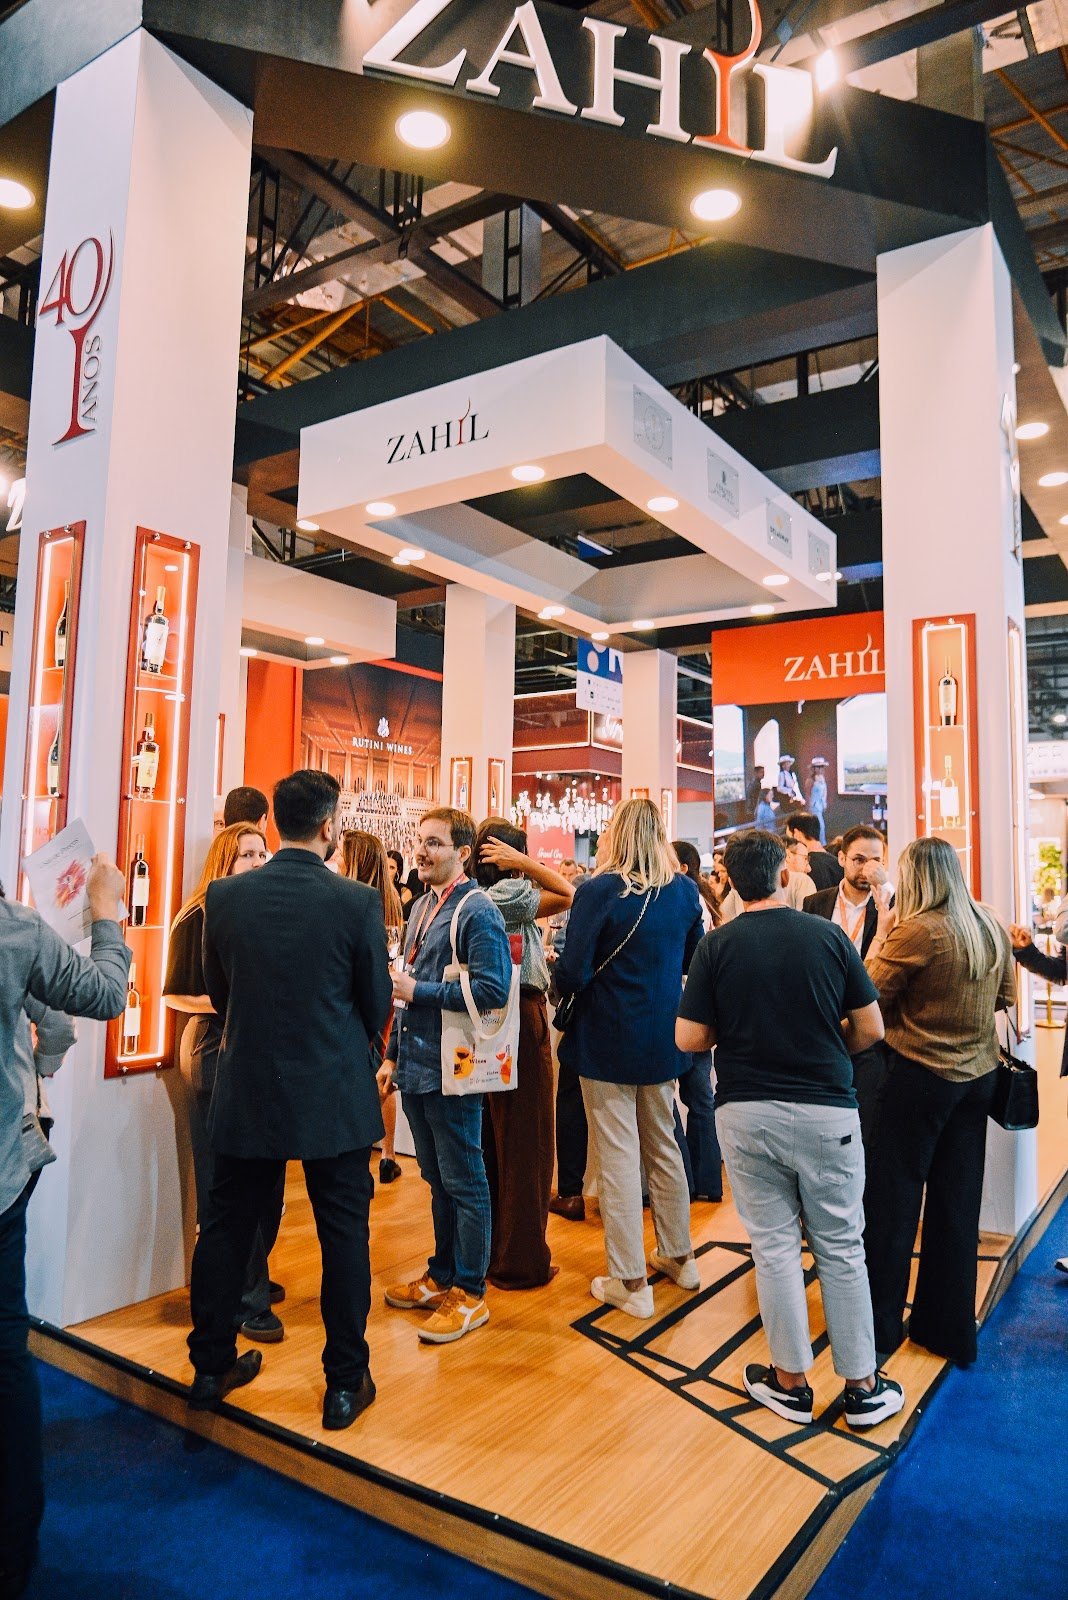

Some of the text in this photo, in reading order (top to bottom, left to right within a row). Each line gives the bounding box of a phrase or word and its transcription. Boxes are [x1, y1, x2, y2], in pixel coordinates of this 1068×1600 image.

[362, 0, 838, 179] ZAHIL
[39, 237, 104, 326] 40
[81, 335, 101, 422] ANOS
[386, 397, 490, 464] ZAHIL
[783, 633, 886, 682] ZAHIL
[352, 736, 413, 756] RUTINI WINES
